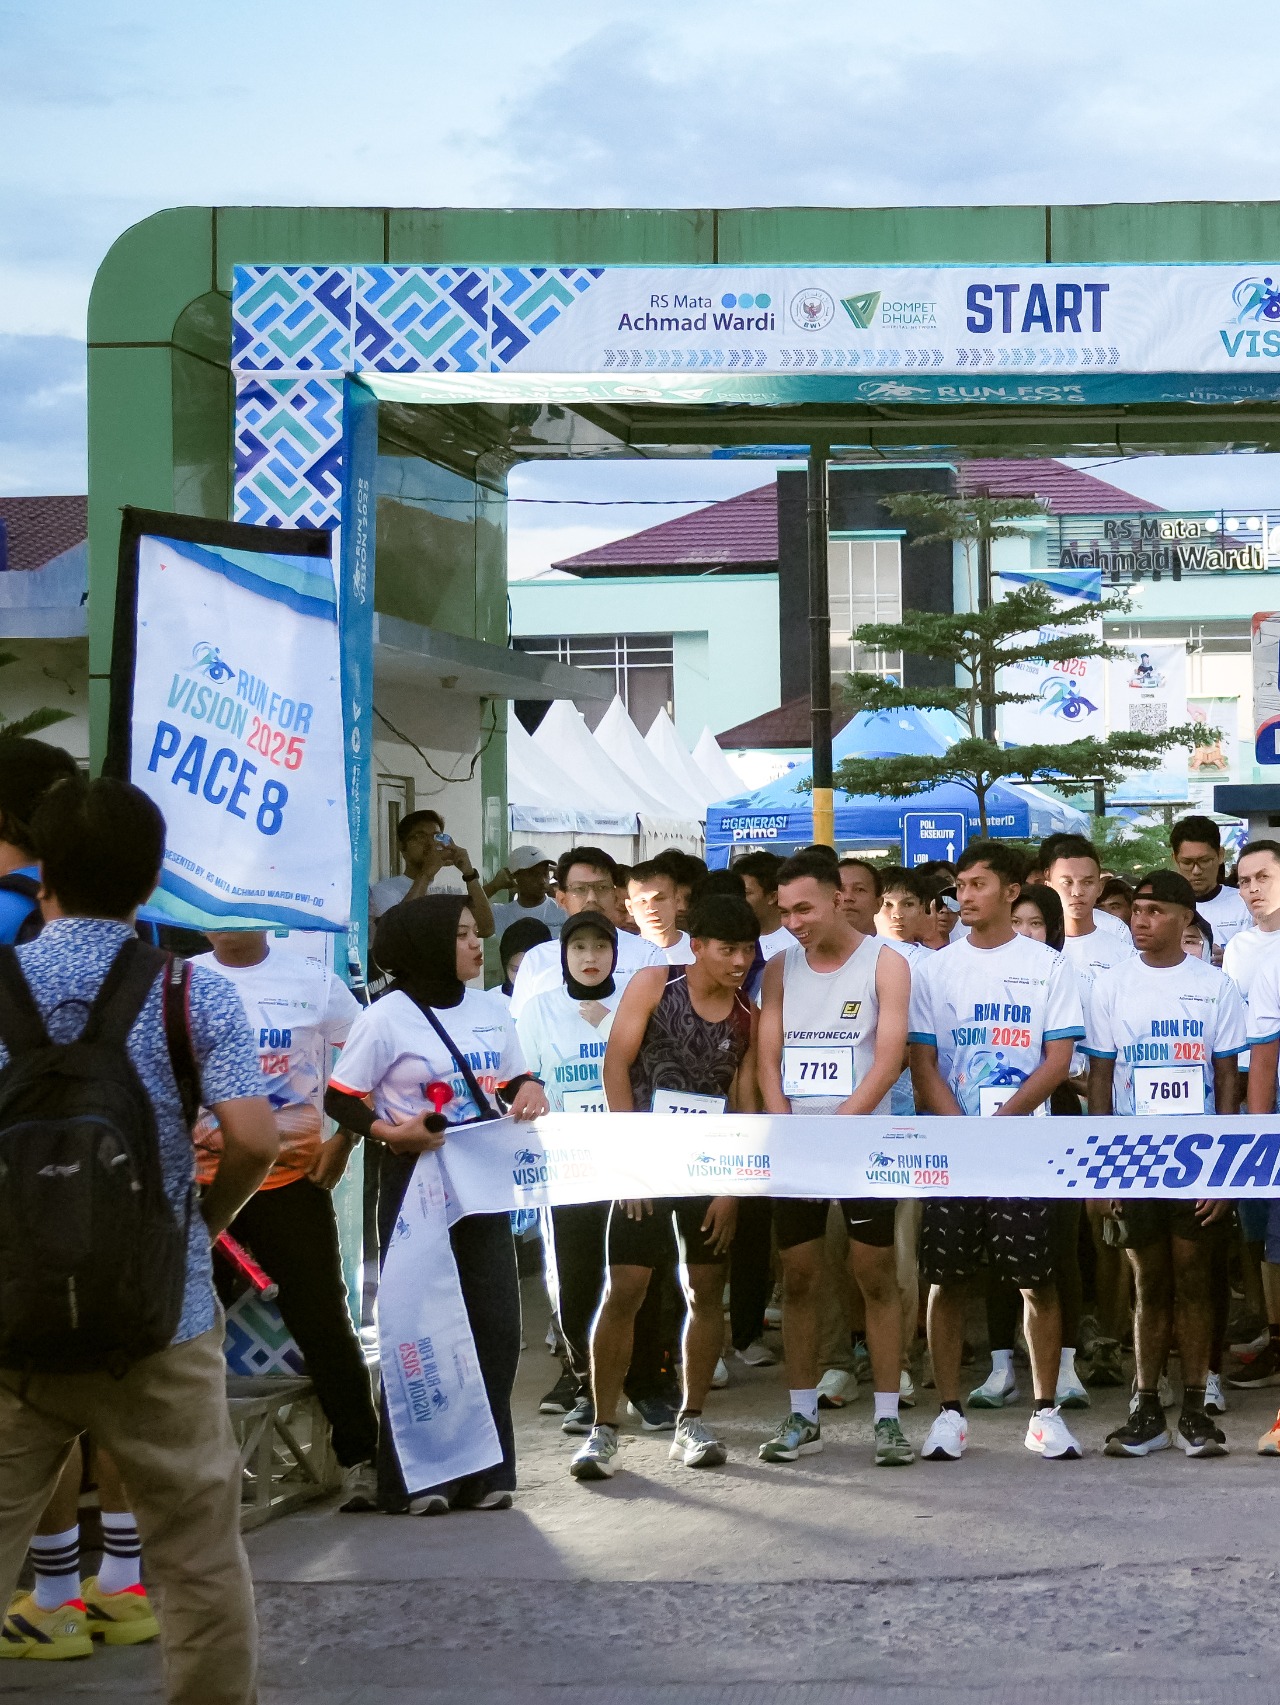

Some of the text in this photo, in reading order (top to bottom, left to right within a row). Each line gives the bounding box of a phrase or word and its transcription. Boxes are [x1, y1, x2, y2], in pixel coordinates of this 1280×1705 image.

[650, 294, 713, 310] RS Mata
[882, 302, 937, 313] DOMPET
[966, 283, 1110, 335] START
[617, 312, 776, 335] Achmad Wardi
[803, 321, 821, 329] BWI
[882, 313, 937, 324] DHUAFA
[937, 385, 1083, 397] RUN FOR
[1103, 518, 1200, 540] RS Mata
[1060, 543, 1264, 572] Achmad Wardi
[237, 668, 314, 735] RUN FOR
[167, 673, 306, 771] VISION 2025
[147, 720, 289, 836] PACE 8
[722, 815, 788, 830] #GENERASI
[920, 820, 935, 830] POLI
[733, 827, 778, 842] prima
[920, 830, 955, 839] EKSEKUTIF
[914, 854, 928, 863] LOBI
[164, 848, 195, 872] RESENTED
[215, 876, 231, 893] MATA
[231, 886, 266, 898] ACHMAD
[267, 889, 294, 900] WARDI
[974, 1003, 1032, 1024] RUN FOR
[1151, 1019, 1179, 1037] RUN
[259, 1028, 292, 1049] FOR
[992, 1027, 1031, 1048] 2025
[1123, 1043, 1169, 1063] VISION
[554, 1064, 599, 1083] VISION
[799, 1062, 838, 1080] 7712
[1149, 1081, 1189, 1100] 7601
[687, 1163, 771, 1177] VISION 2025
[719, 1154, 771, 1169] RUN FOR
[897, 1154, 949, 1169] RUN FOR
[512, 1165, 559, 1186] VISION
[865, 1170, 910, 1185] VISION
[914, 1170, 950, 1186] 2025
